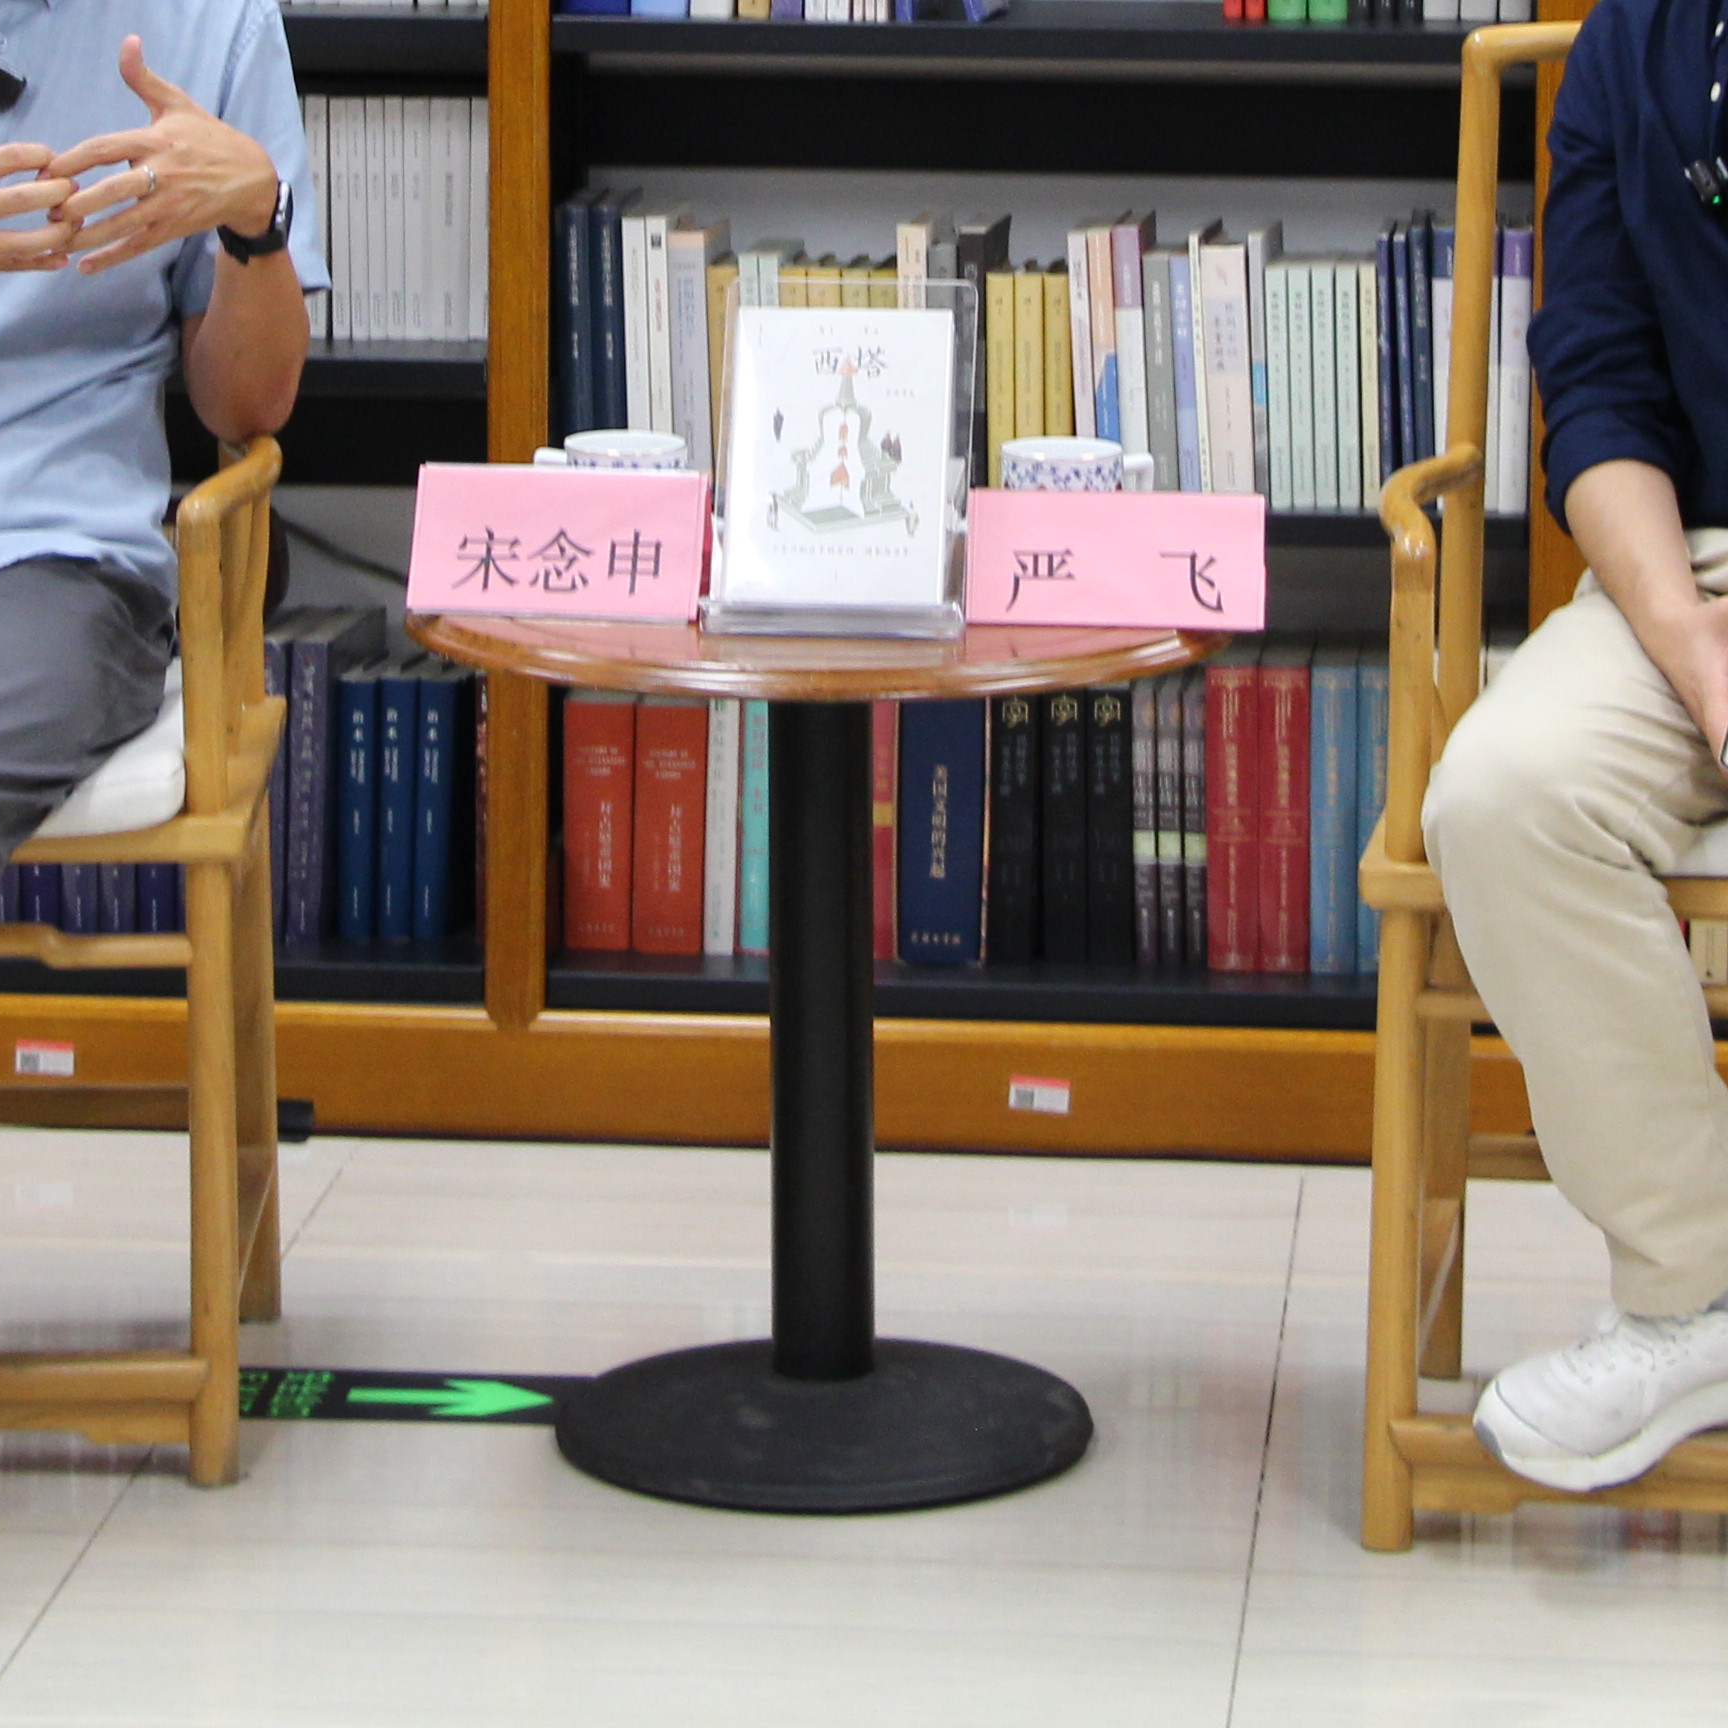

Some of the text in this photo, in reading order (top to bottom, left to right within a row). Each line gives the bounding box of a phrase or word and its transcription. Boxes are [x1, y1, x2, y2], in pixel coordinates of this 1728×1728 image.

[812, 344, 889, 380] 西塔
[453, 527, 665, 597] 宋念申
